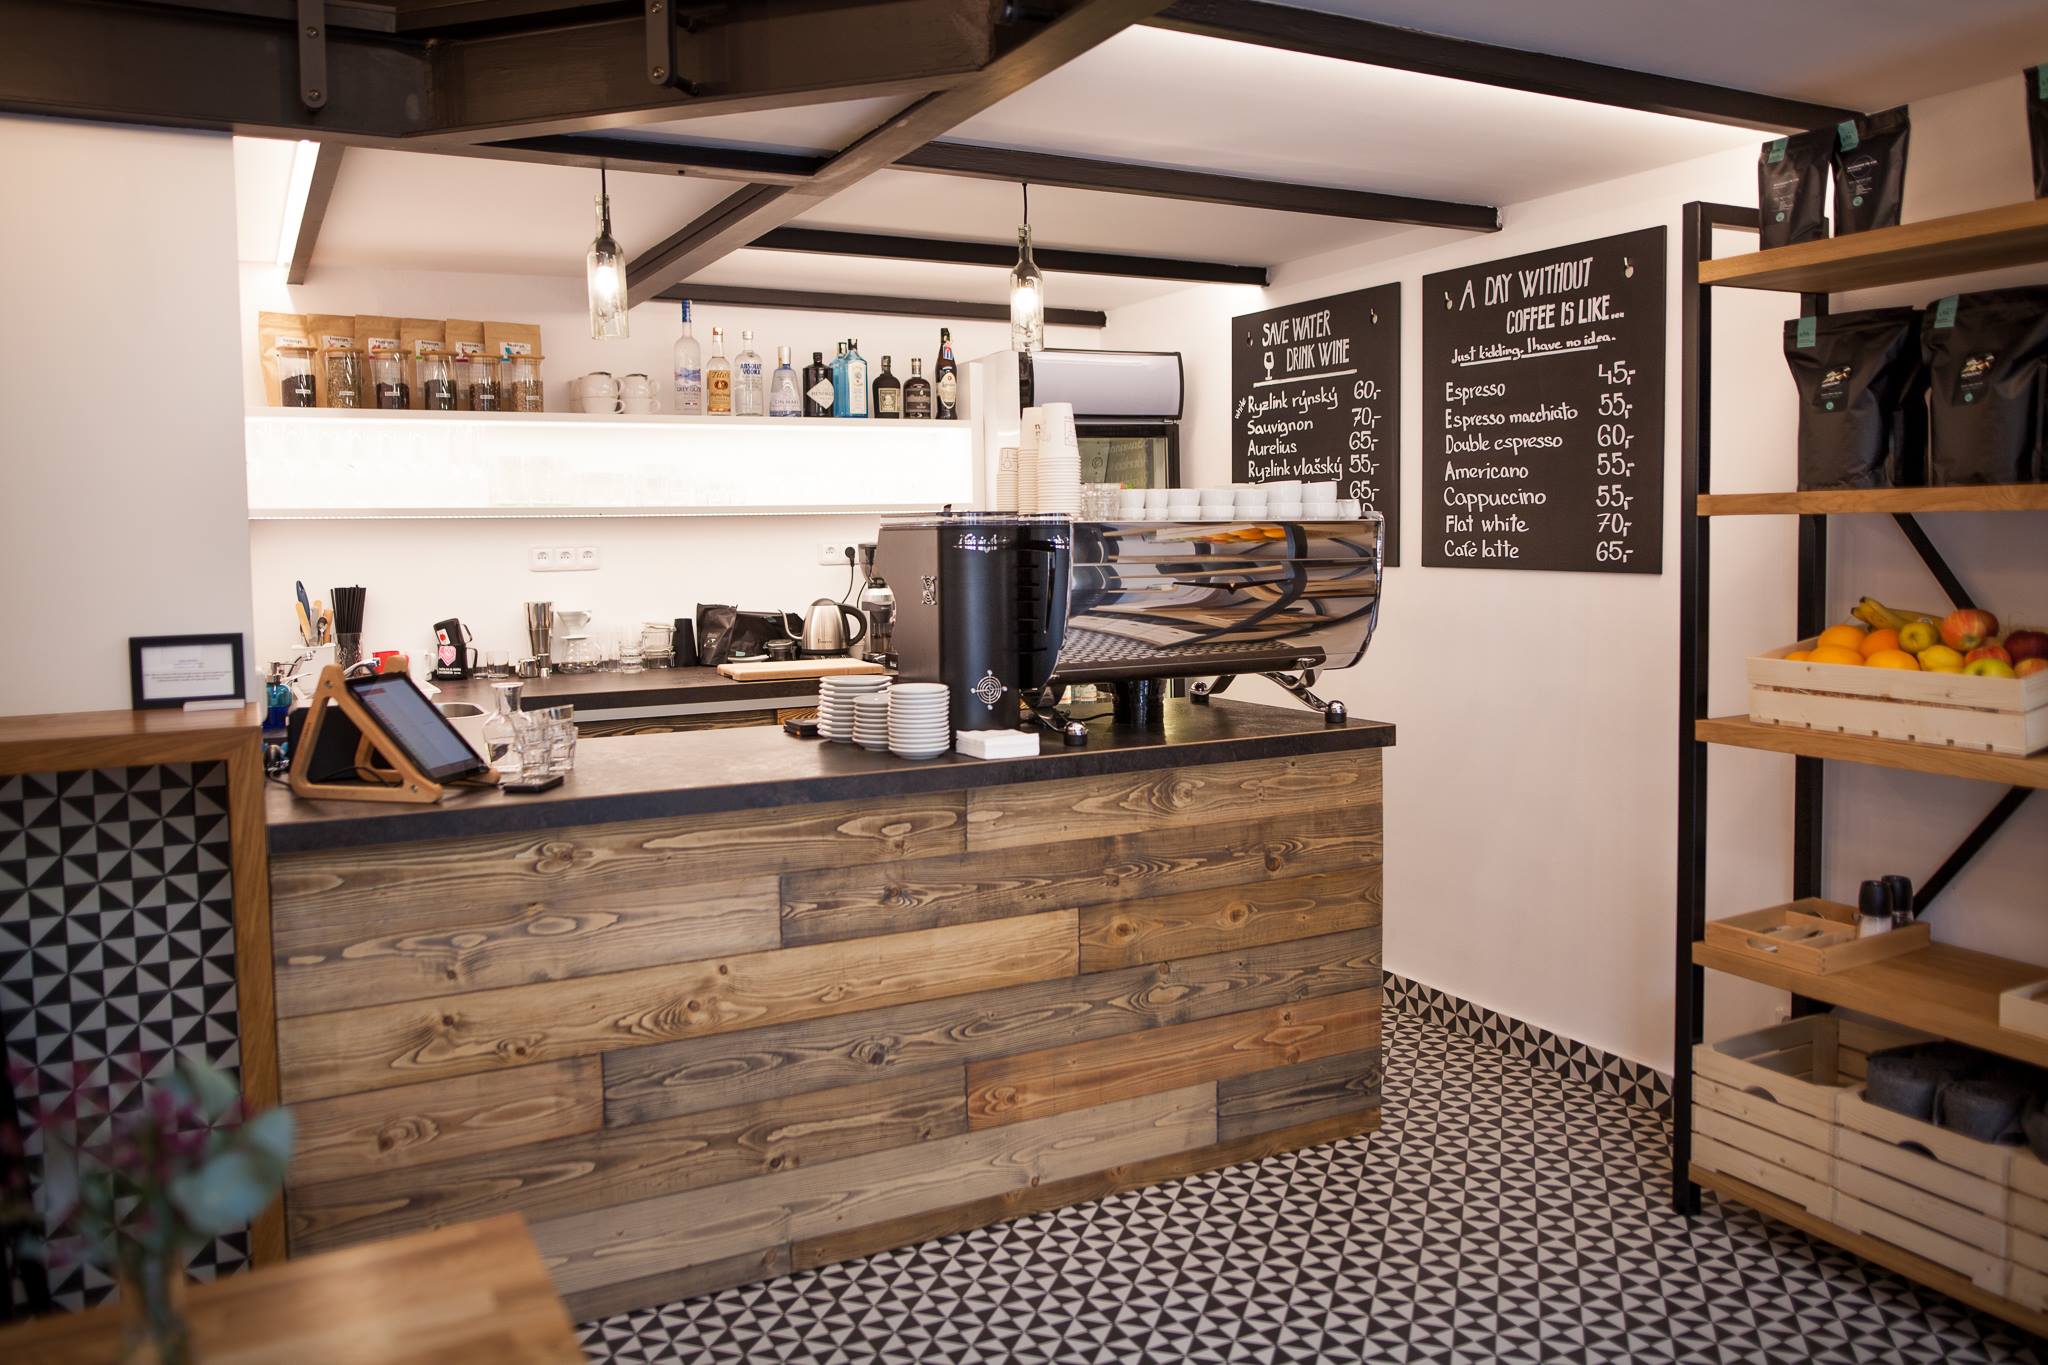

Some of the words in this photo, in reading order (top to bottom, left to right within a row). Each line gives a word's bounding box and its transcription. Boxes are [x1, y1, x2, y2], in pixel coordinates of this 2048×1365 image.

[1459, 280, 1476, 311] A
[1484, 273, 1513, 306] DAY
[1519, 257, 1594, 299] WITHOUT
[1506, 303, 1556, 335] COFFEE
[1560, 301, 1575, 327] IS
[1578, 294, 1625, 325] LIKE...
[1262, 319, 1290, 347] SAVE
[1292, 309, 1331, 342] WATER
[1286, 343, 1315, 372] DRINK
[1318, 338, 1350, 367] WINE
[1451, 348, 1476, 364] Just
[1532, 337, 1563, 351] have
[1566, 338, 1581, 349] no
[1584, 331, 1616, 345] idea.
[1248, 391, 1288, 419] Ryzlink
[1292, 386, 1339, 414] rýnský
[1445, 381, 1506, 406] Espresso
[1247, 419, 1314, 437] Sauvignon
[1445, 408, 1506, 431] Espresso
[1509, 401, 1578, 424] macchiato
[1247, 438, 1298, 456] Aurelius
[1445, 433, 1491, 455] Double
[1494, 435, 1563, 456] espresso
[1248, 458, 1291, 483] Ryzlink
[1293, 456, 1343, 481] vlašský
[1444, 460, 1529, 482] Americano
[1443, 486, 1547, 512] Cappuccino
[1445, 514, 1474, 533] Flat
[1481, 513, 1530, 533] white
[1481, 539, 1520, 559] latte
